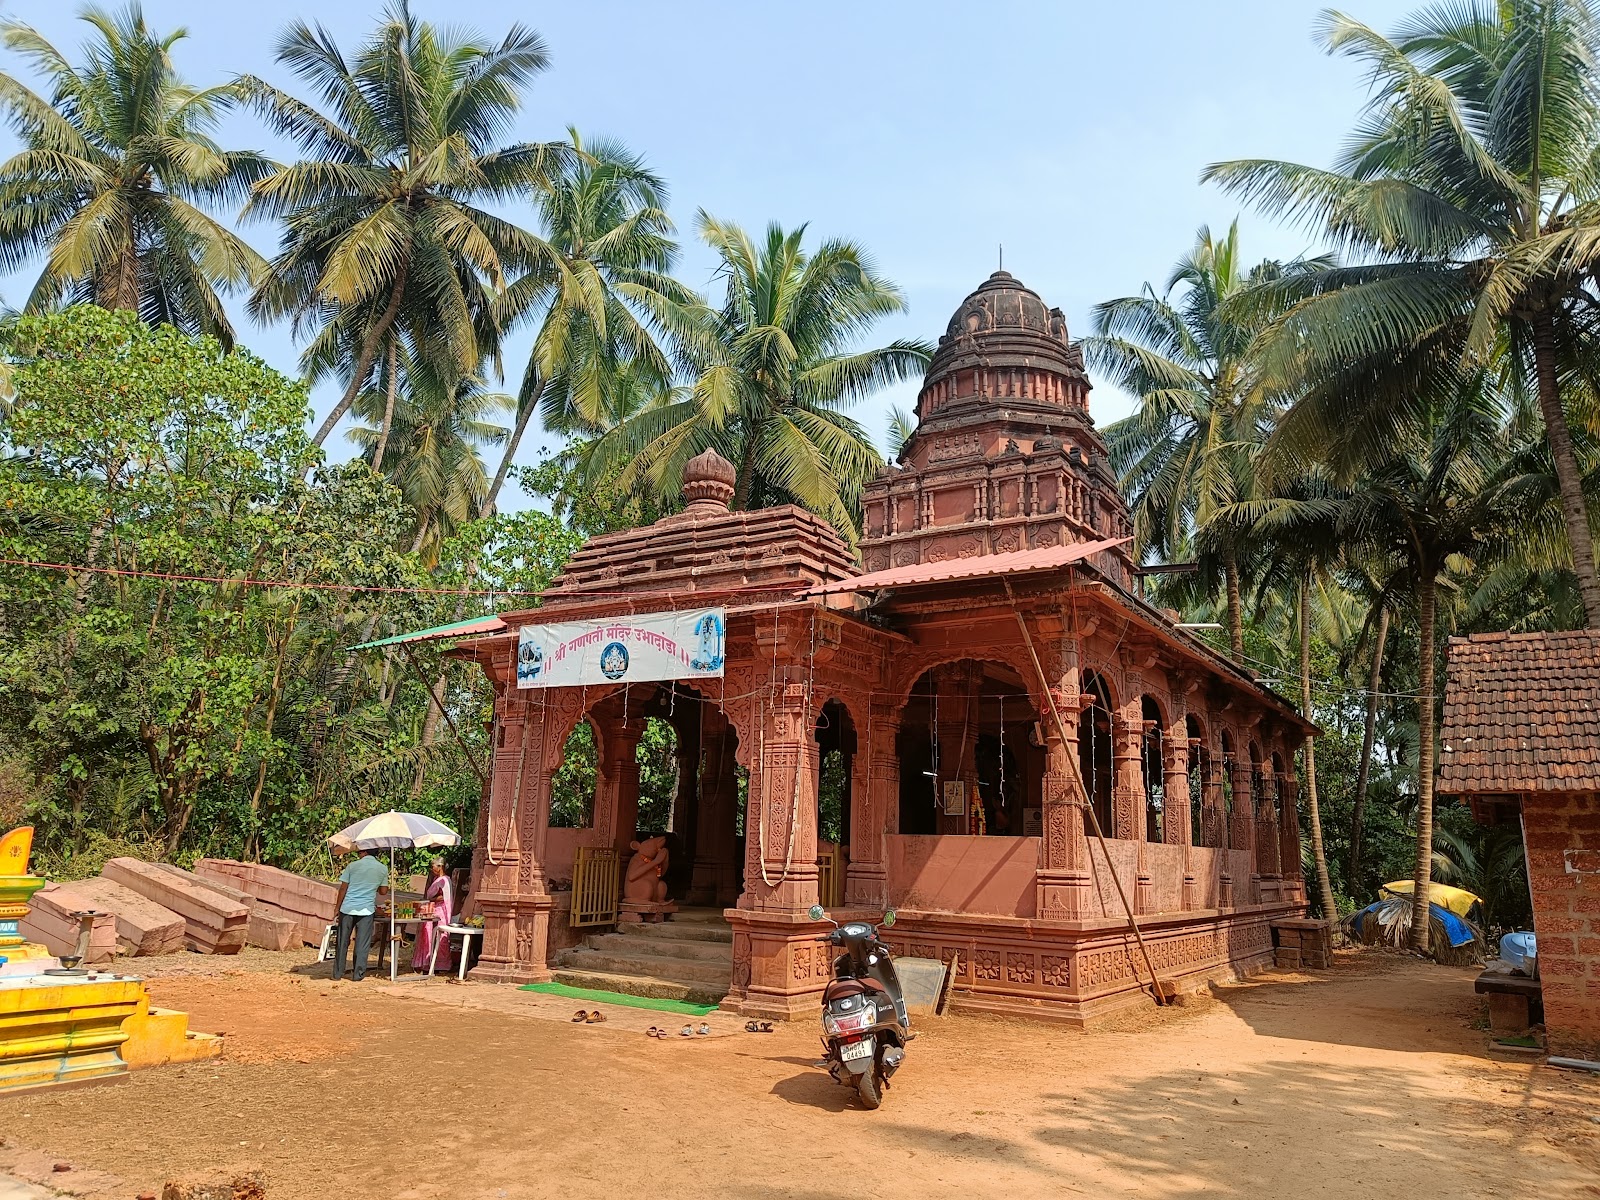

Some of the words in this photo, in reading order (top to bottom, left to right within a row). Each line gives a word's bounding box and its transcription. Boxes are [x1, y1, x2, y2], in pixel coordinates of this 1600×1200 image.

[555, 642, 567, 661] श्री
[568, 625, 604, 651] गणपती
[606, 623, 632, 641] मंदिर
[634, 628, 677, 657] उभादांडा
